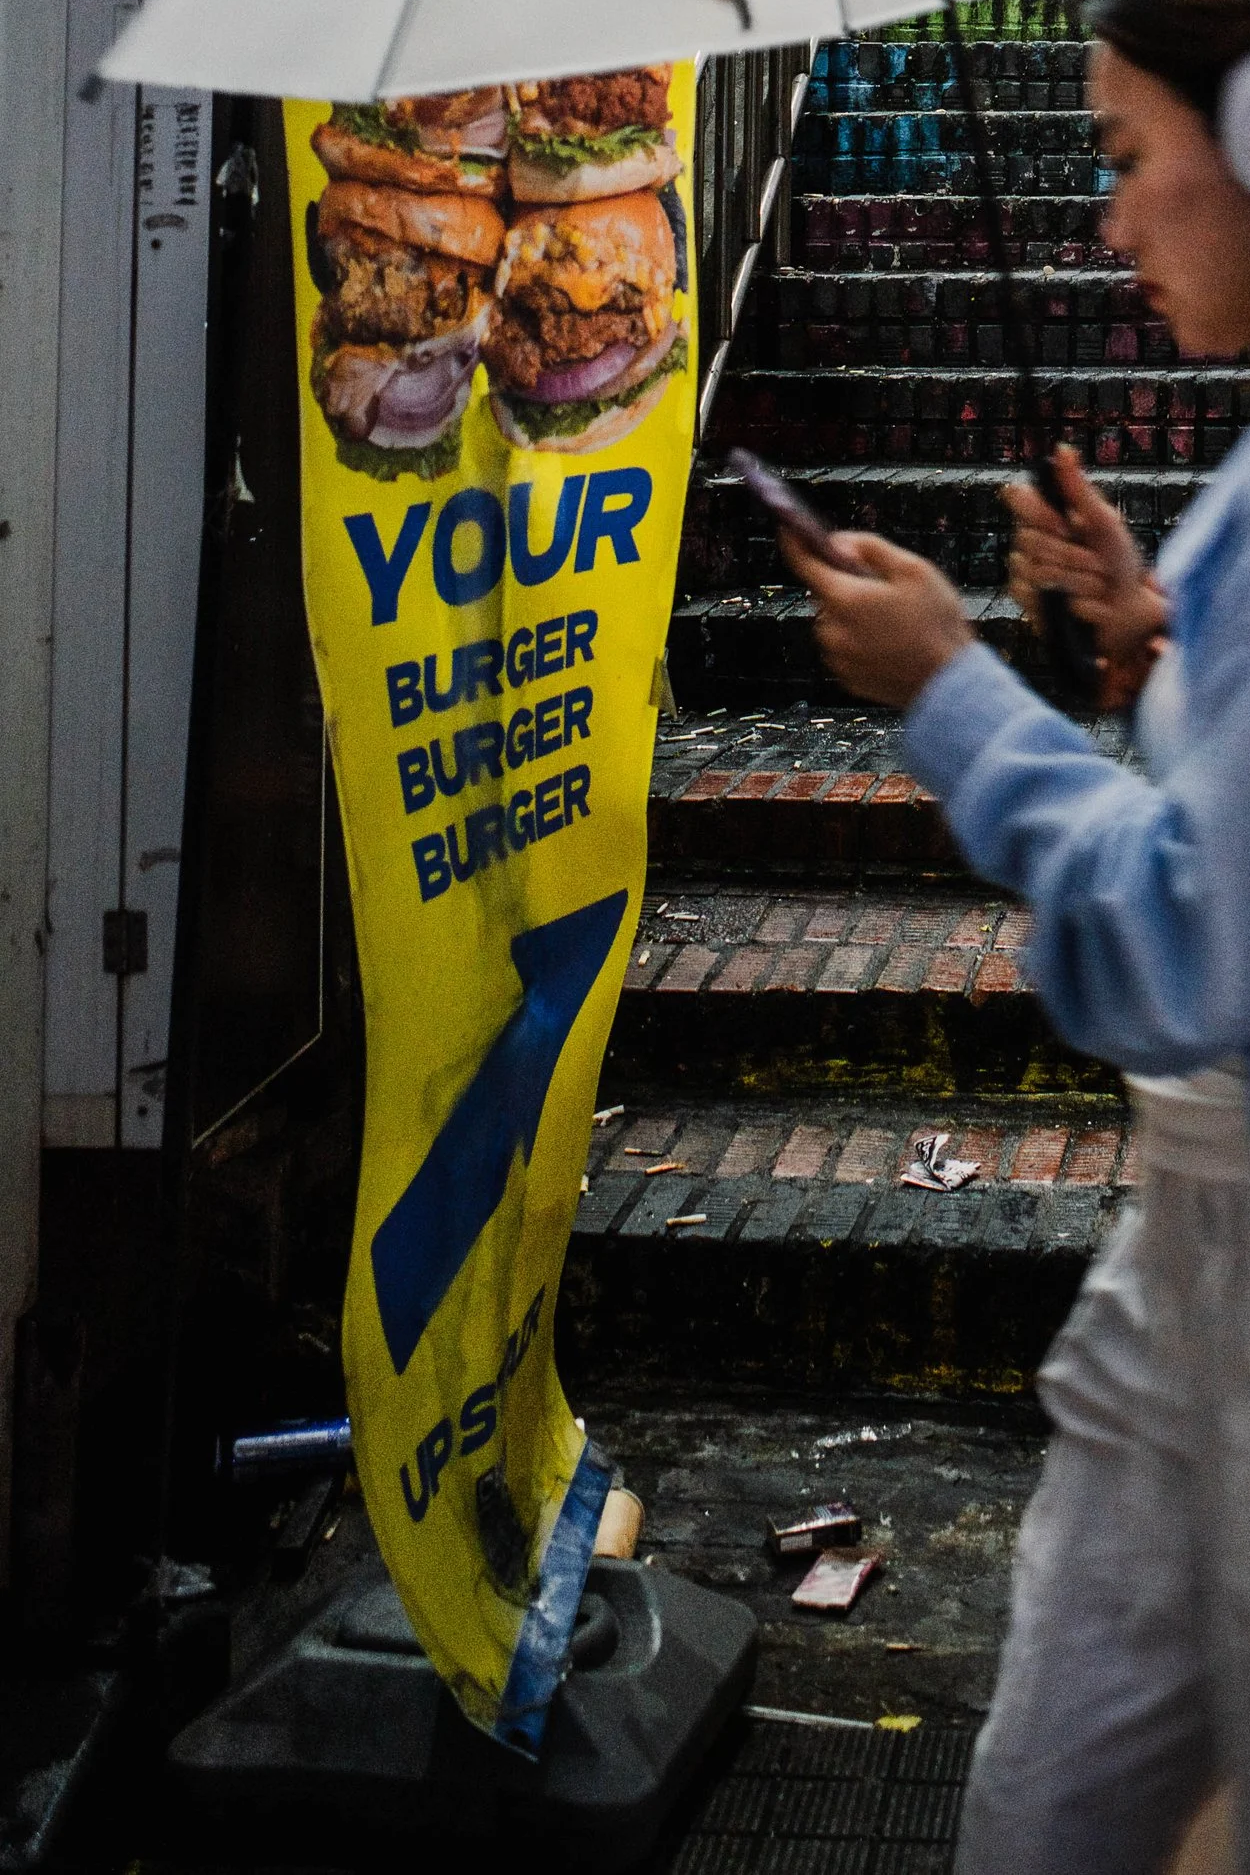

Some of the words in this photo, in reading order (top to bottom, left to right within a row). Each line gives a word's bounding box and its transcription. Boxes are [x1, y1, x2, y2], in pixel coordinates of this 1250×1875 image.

[342, 466, 653, 627] YOUR
[385, 608, 600, 729] BURGER
[397, 685, 594, 815] BURGER
[411, 763, 592, 903] BURGER
